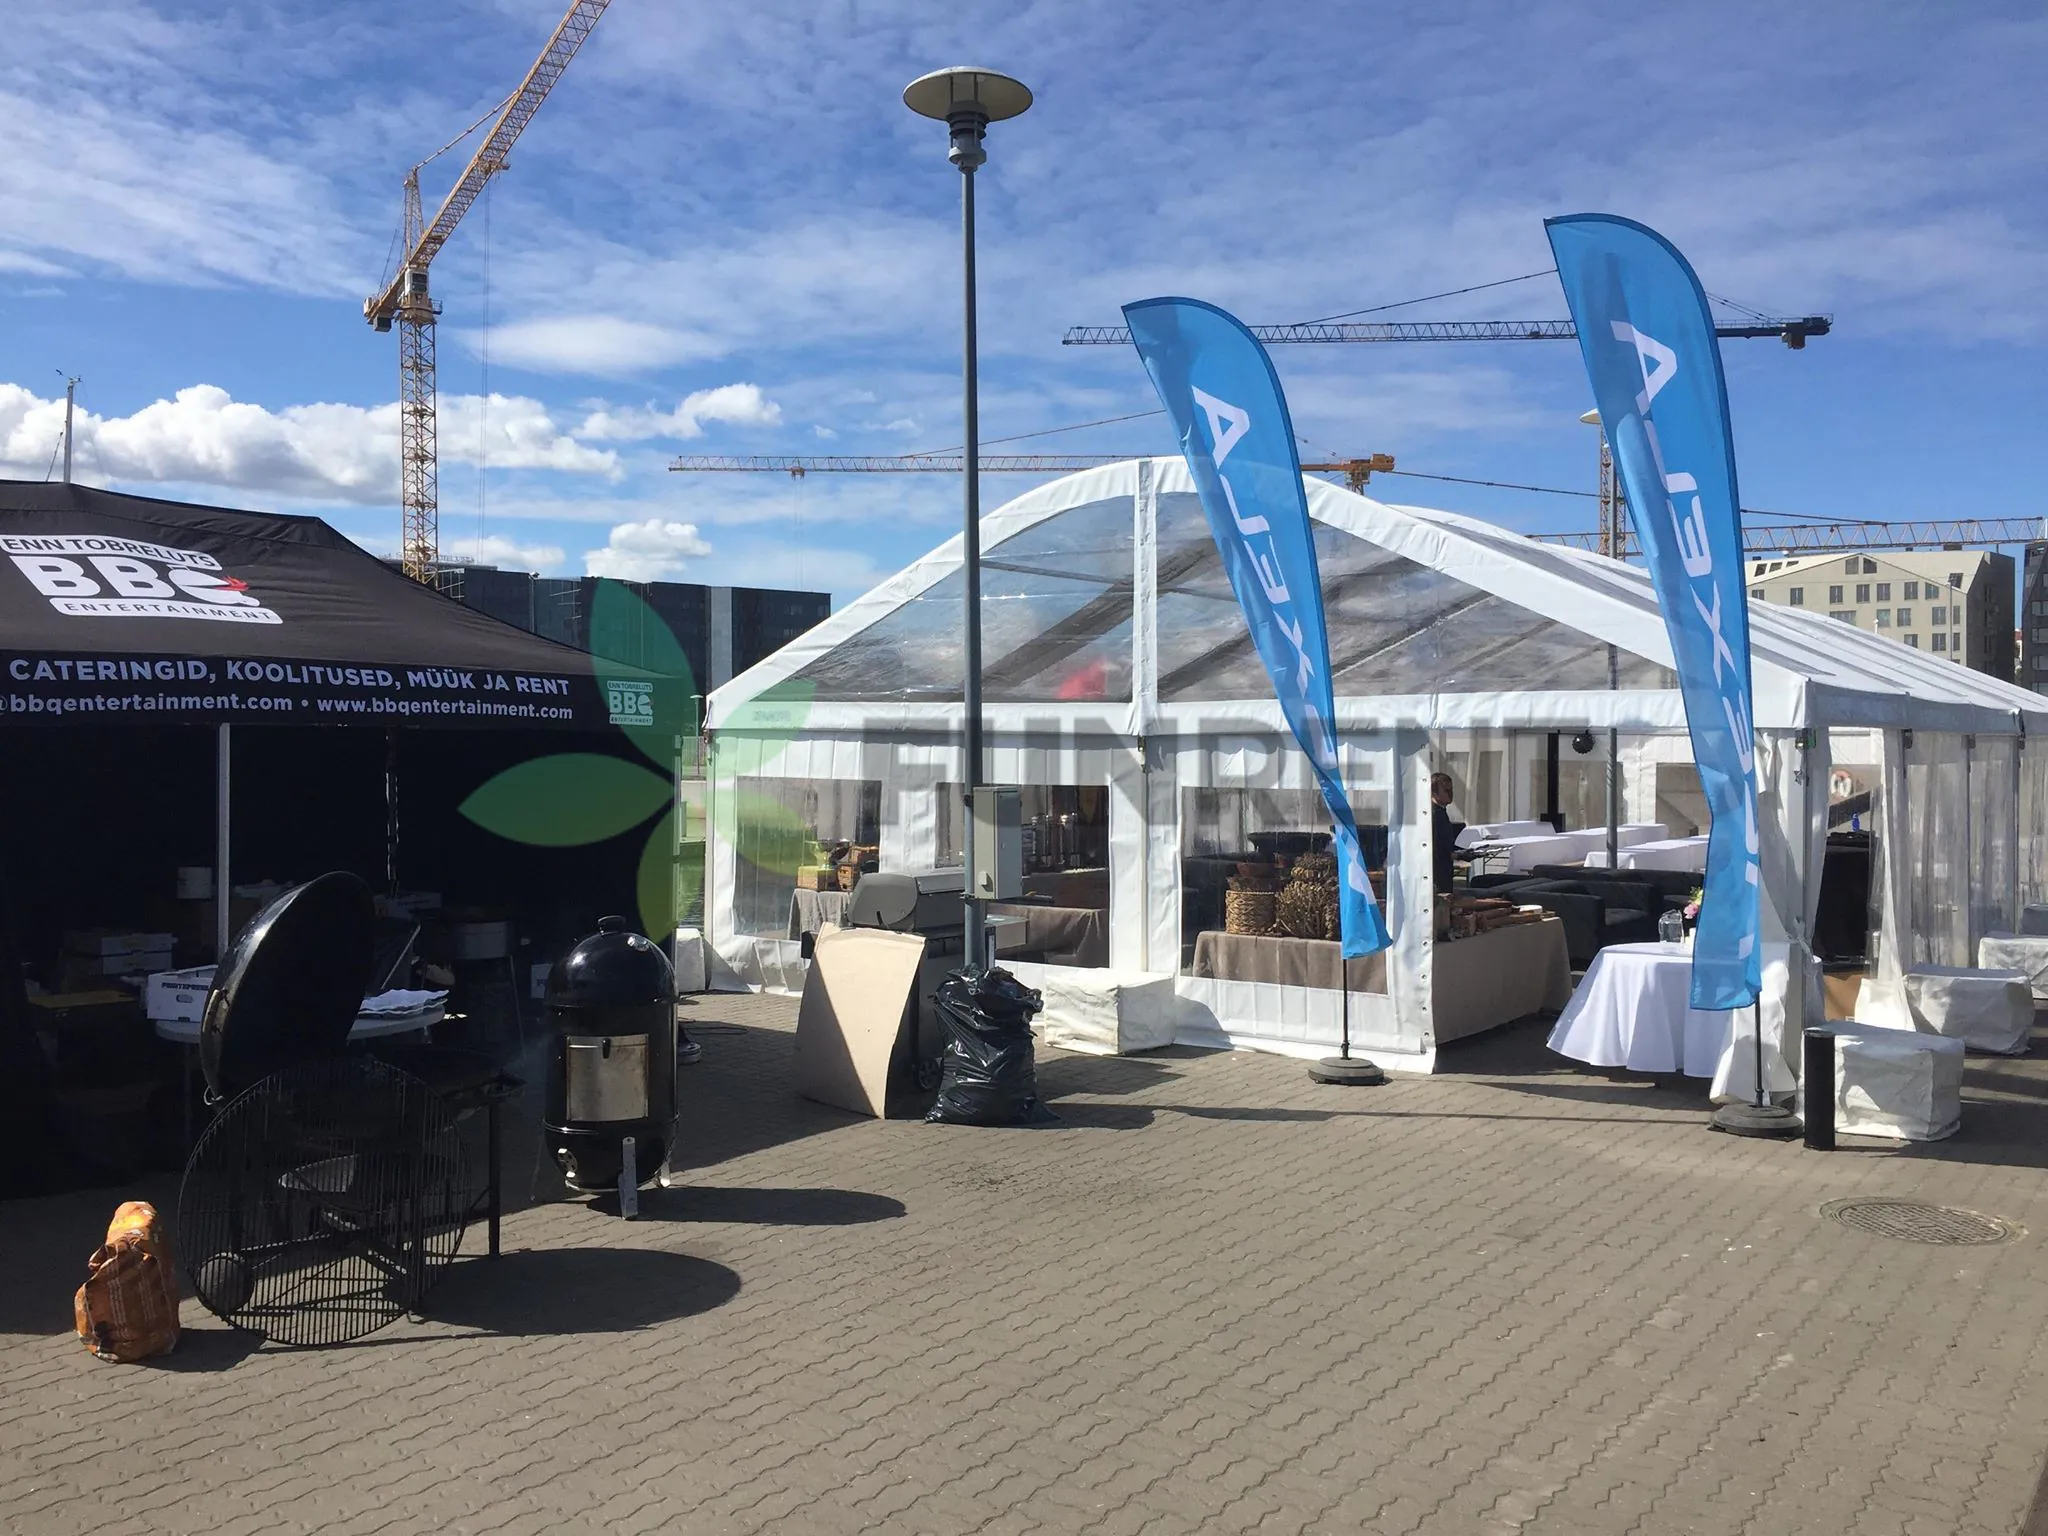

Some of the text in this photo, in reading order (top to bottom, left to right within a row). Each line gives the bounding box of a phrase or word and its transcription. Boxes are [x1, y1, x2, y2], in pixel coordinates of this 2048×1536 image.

[2, 538, 216, 568] ENN TOBRELUTS
[64, 602, 272, 621] ENTERTAINMENT
[9, 659, 569, 696] CATERINGID, KOOLITUSED, MÜÜK JA RENT
[317, 697, 574, 720] www.bbqentertainment.com
